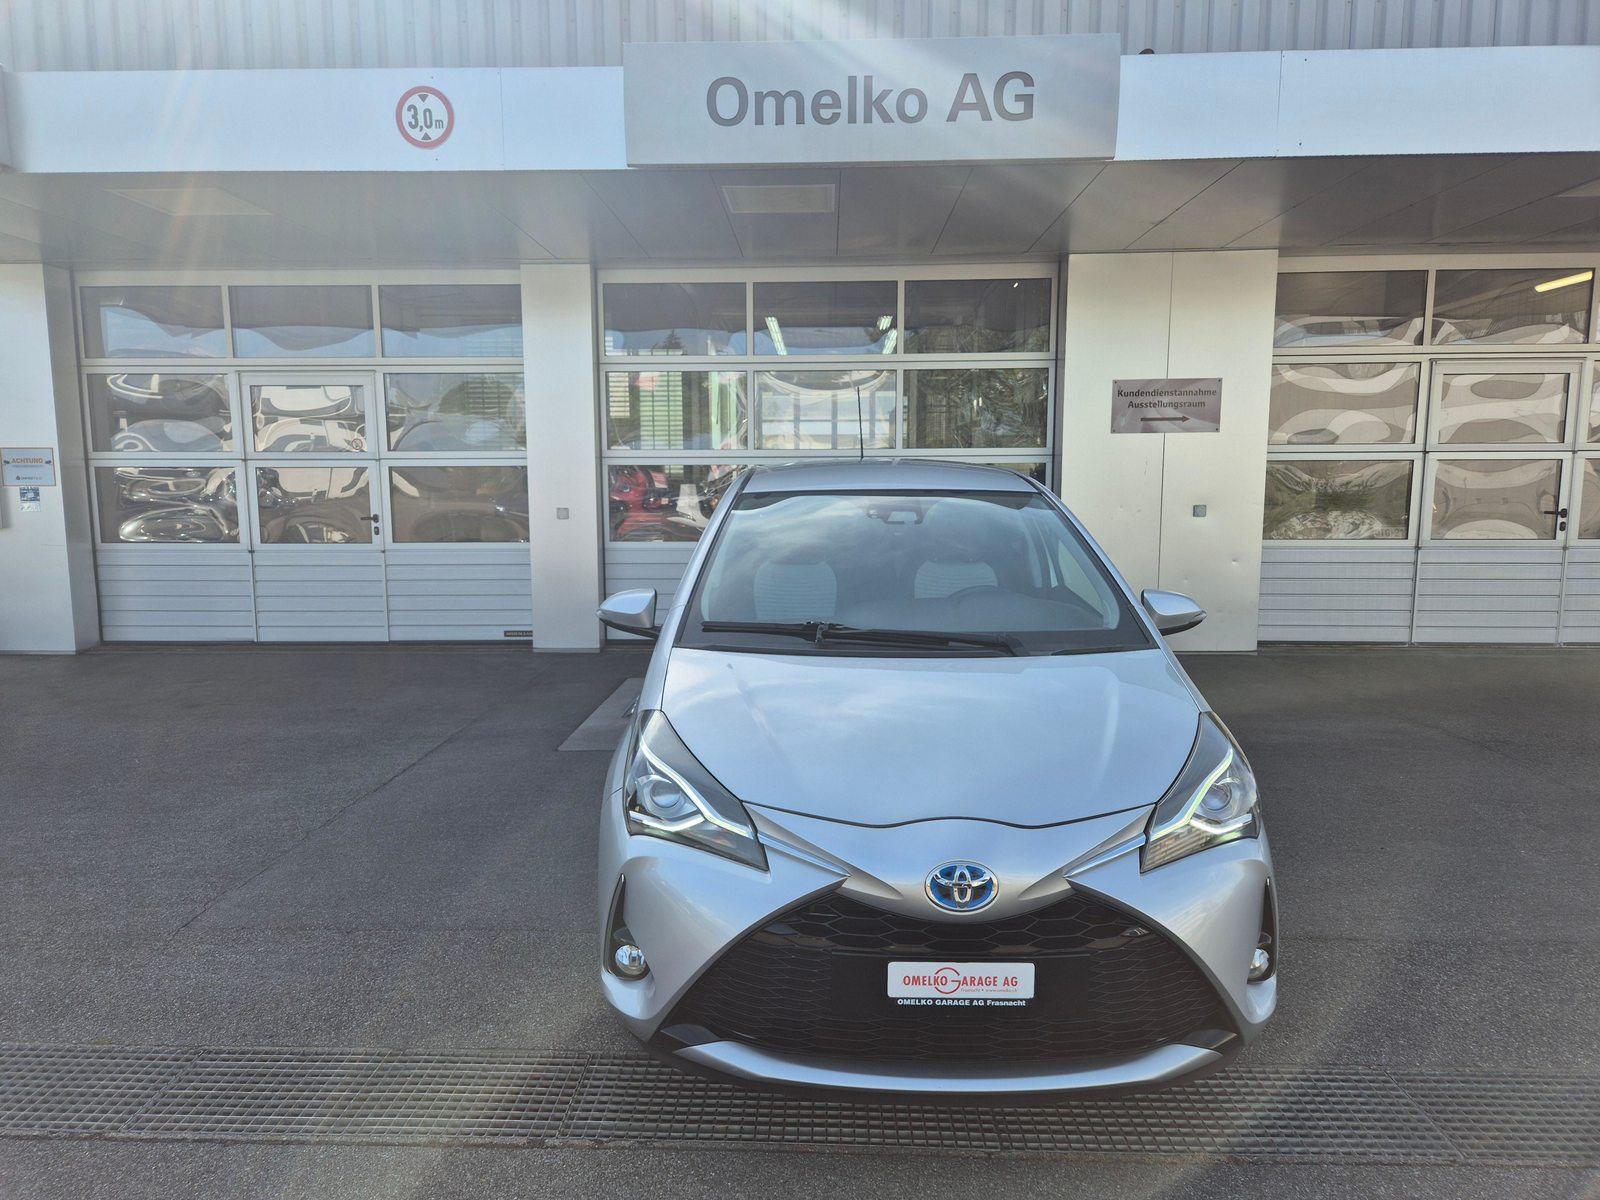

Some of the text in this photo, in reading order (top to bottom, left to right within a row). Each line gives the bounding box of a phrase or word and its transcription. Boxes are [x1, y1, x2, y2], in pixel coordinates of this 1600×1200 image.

[706, 70, 1036, 127] Omelko AG
[1117, 388, 1217, 397] Kundendienstannahme
[1127, 400, 1206, 409] Ausstellungsraum
[903, 975, 948, 986] OMELKO
[1002, 976, 1018, 987] AG
[897, 998, 933, 1006] OMELKO
